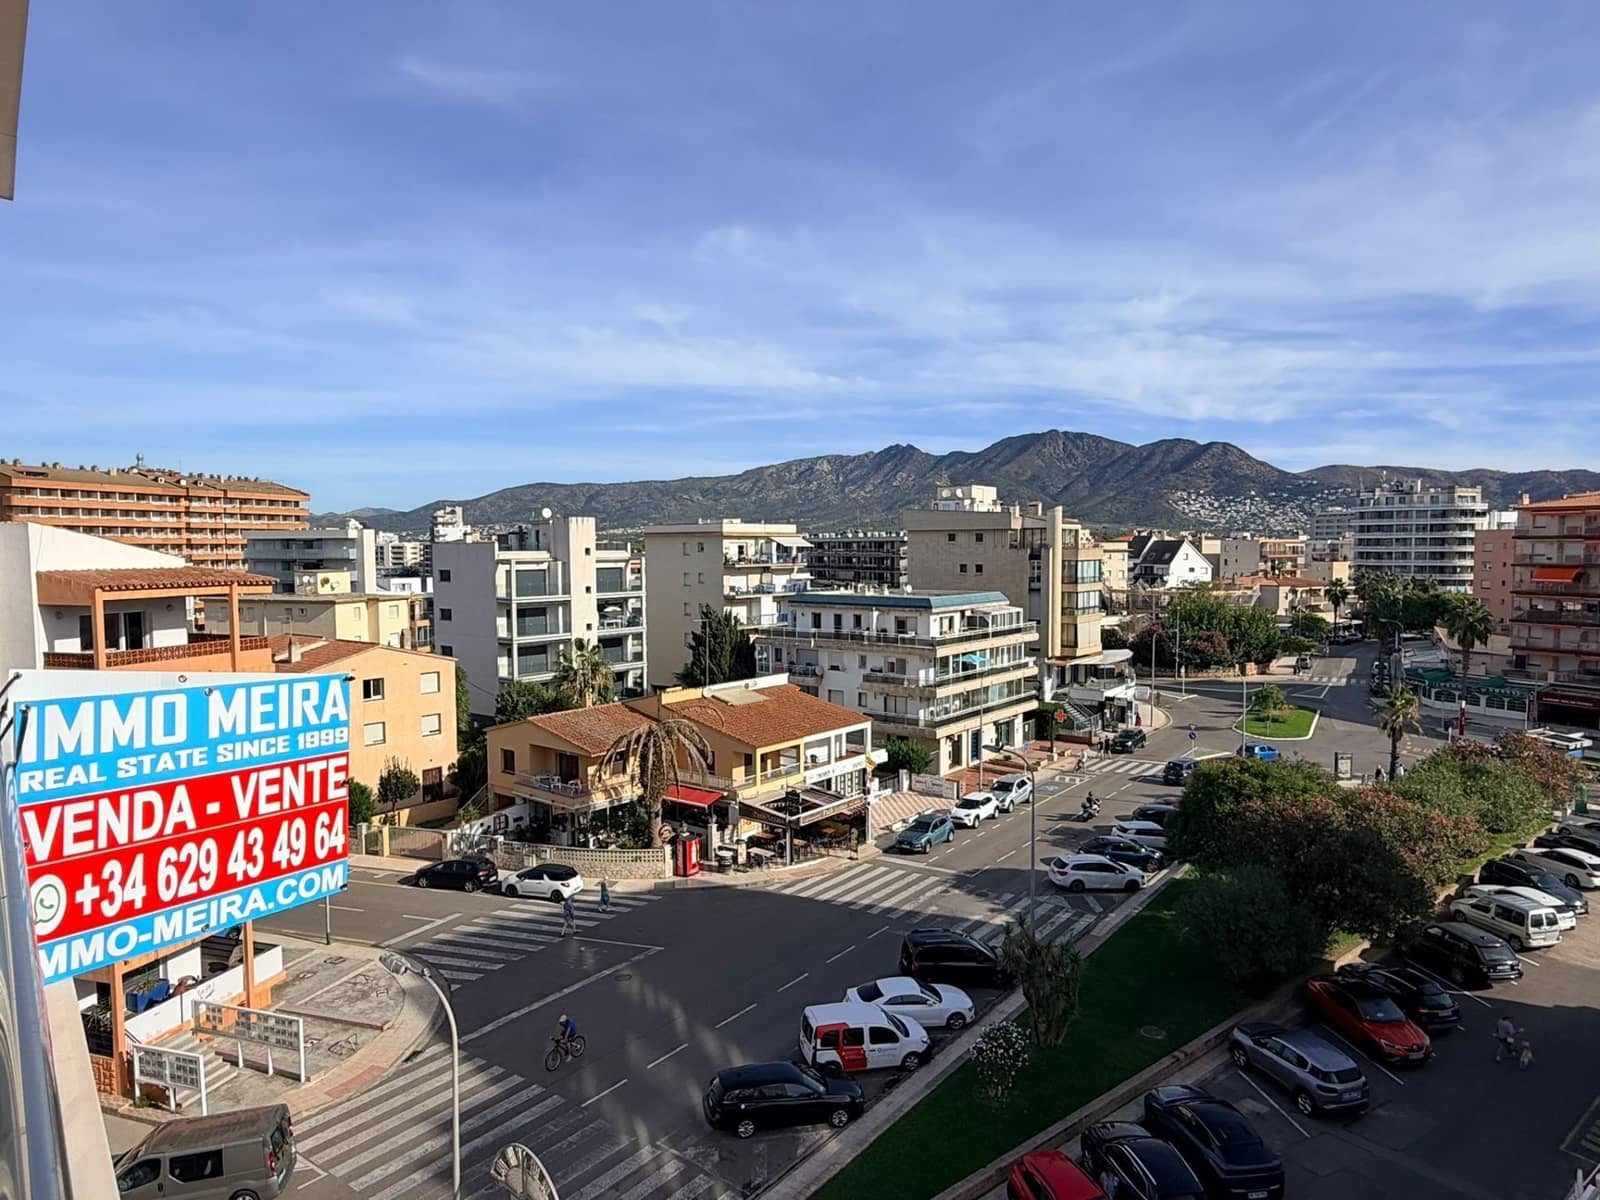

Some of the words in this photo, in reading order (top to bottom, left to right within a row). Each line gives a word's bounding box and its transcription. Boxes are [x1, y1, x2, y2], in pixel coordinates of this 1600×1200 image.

[19, 762, 107, 793] REAL
[117, 747, 208, 778] STATE
[216, 735, 291, 763] SINCE
[297, 726, 348, 750] 1999
[21, 693, 187, 764] IMMO
[208, 679, 348, 739] MEIRA
[23, 784, 197, 862] VENDA
[231, 756, 348, 819] VENTE
[75, 853, 146, 918] +34
[157, 837, 218, 902] 629
[227, 827, 264, 882] 43
[272, 817, 306, 869] 49
[315, 808, 345, 859] 64
[37, 864, 345, 979] MMO-MEIRA.COM
